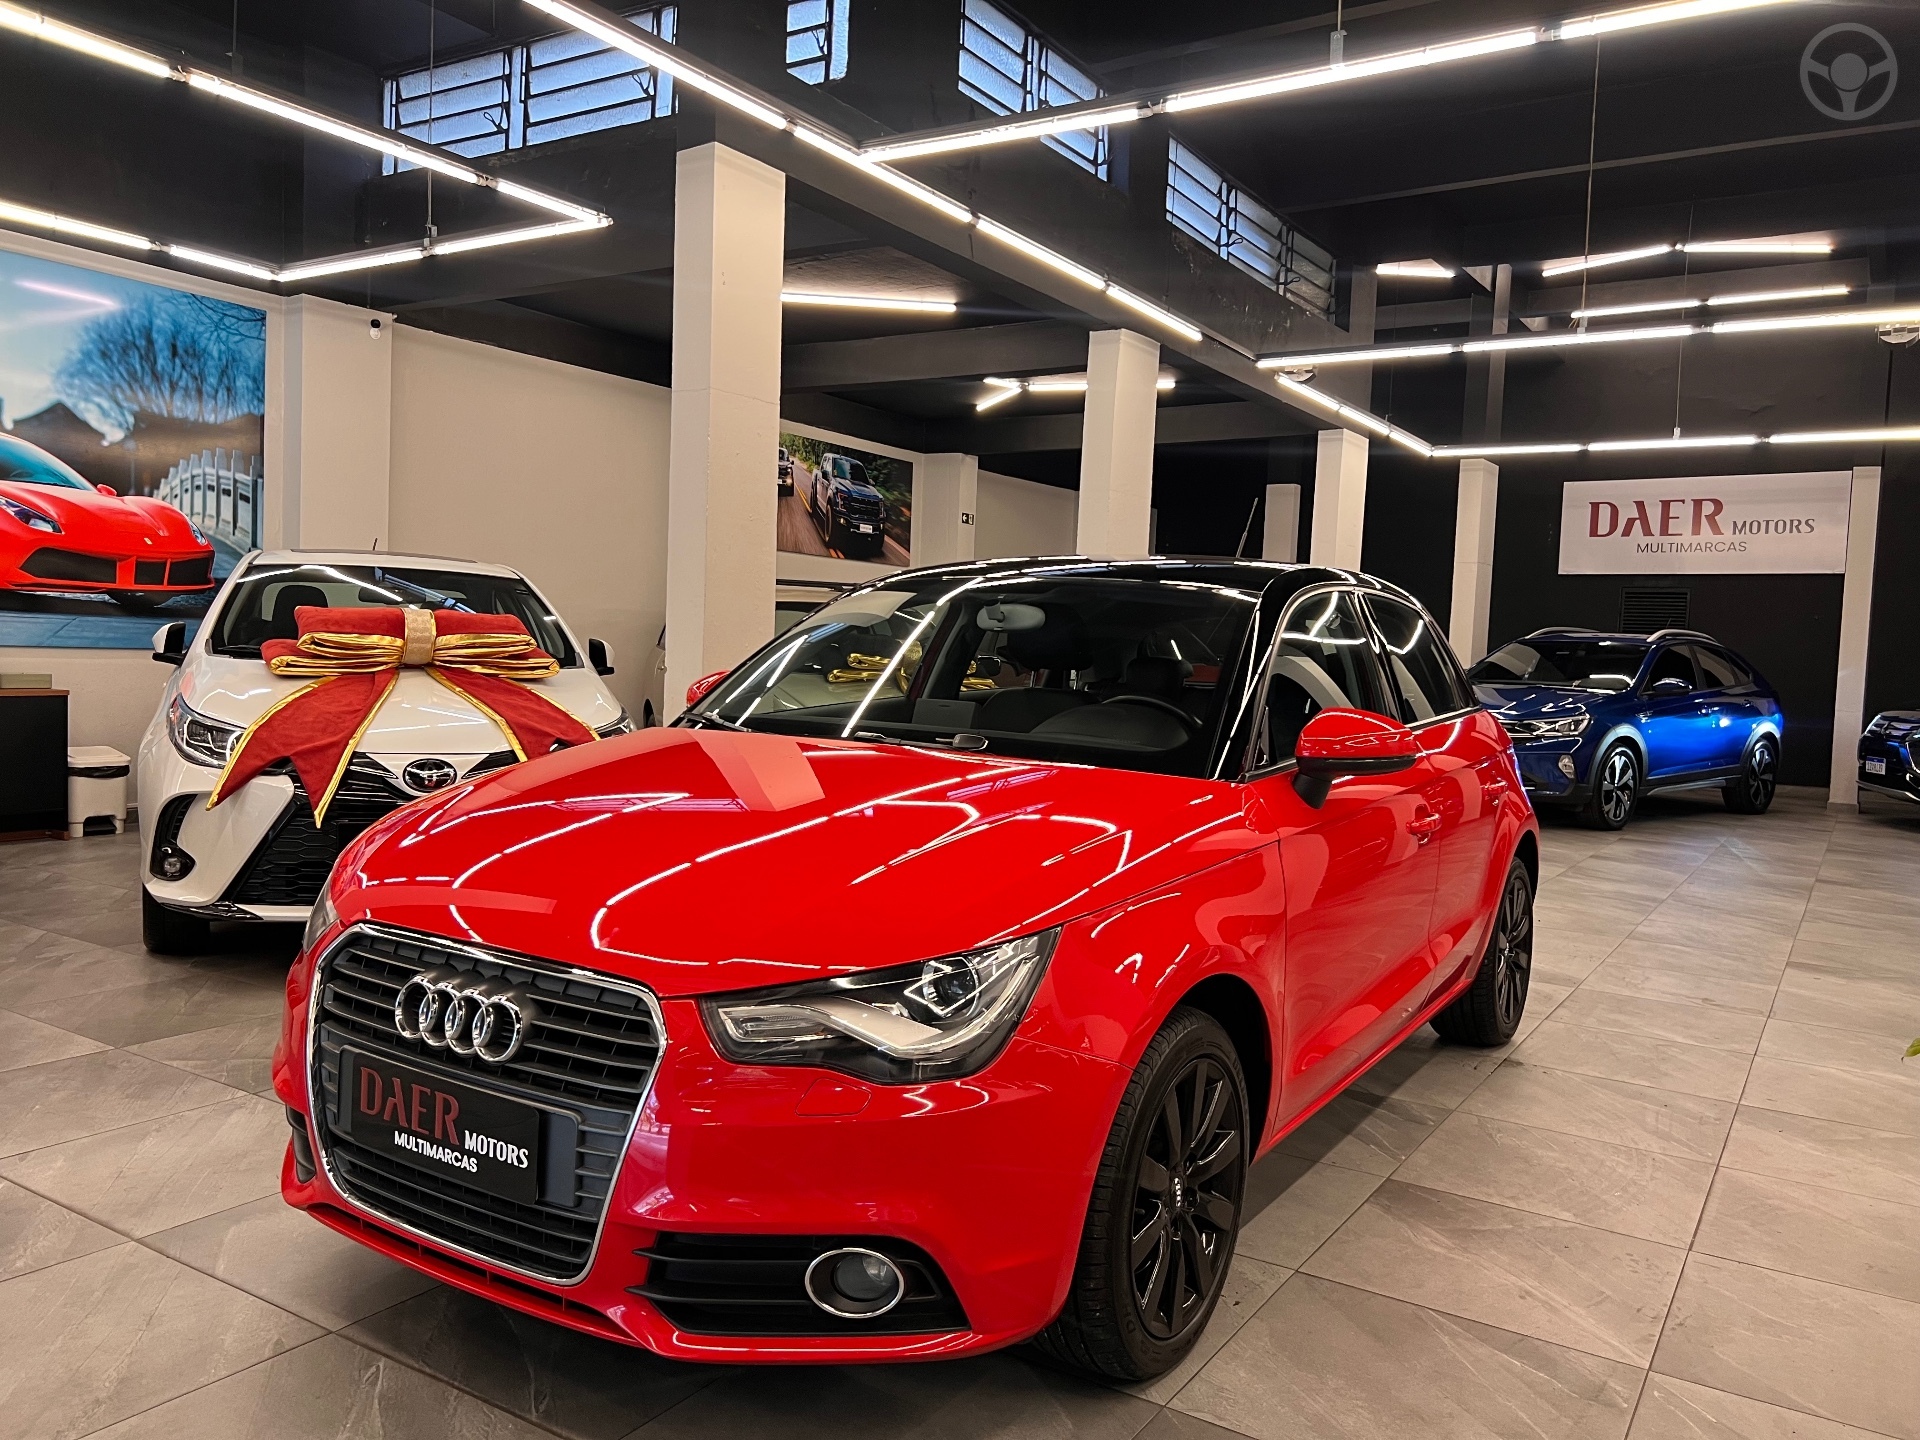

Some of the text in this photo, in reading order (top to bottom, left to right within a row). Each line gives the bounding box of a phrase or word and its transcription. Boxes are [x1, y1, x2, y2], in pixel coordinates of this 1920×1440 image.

[1588, 498, 1815, 537] DAER MOTORS
[1636, 541, 1747, 553] MULTIMARCAS
[360, 1066, 529, 1169] DAER MOTORS
[394, 1131, 478, 1173] MULTIMARCAS
